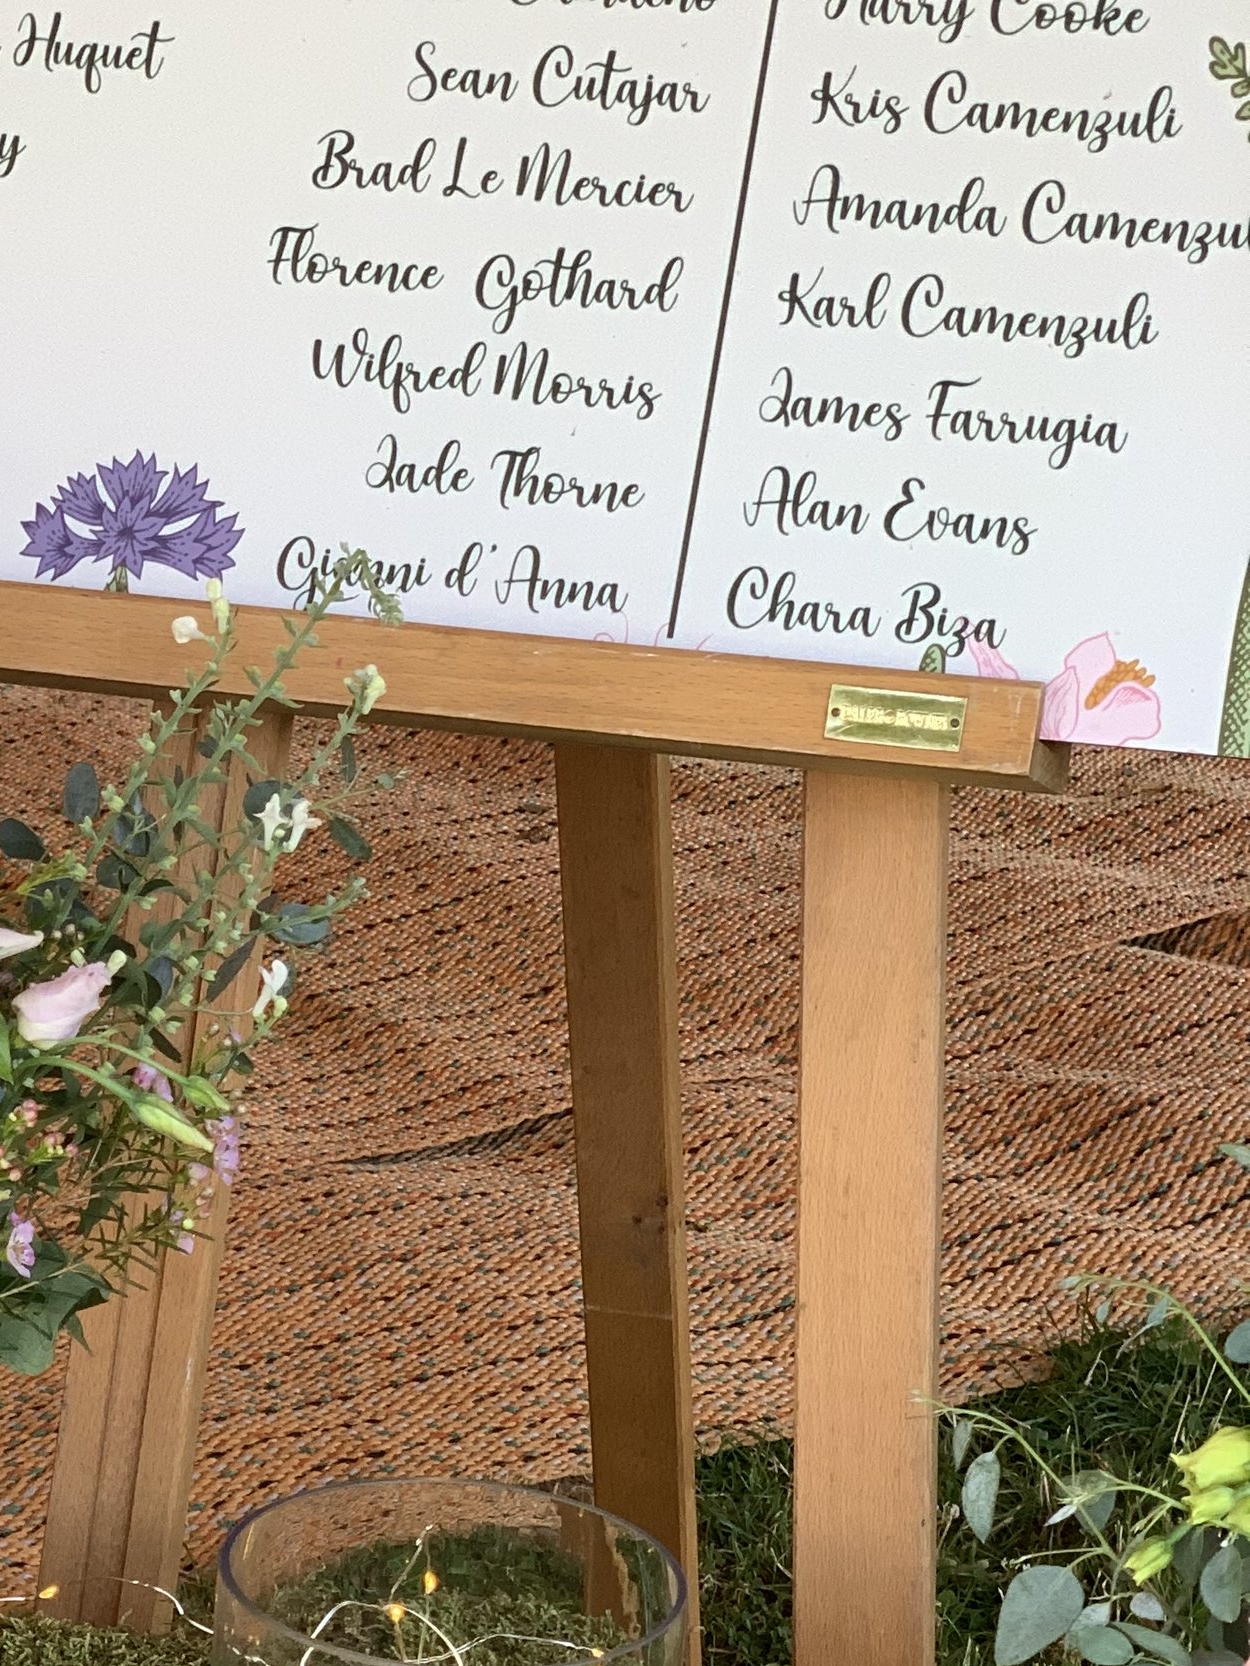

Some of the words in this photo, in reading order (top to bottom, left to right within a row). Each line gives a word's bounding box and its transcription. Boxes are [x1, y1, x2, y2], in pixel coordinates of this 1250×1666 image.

[13, 11, 175, 94] Huquet
[990, 0, 1150, 37] Cooke
[407, 40, 519, 102] Sean
[532, 44, 711, 126] Cutajar
[810, 65, 910, 135] Kris
[924, 69, 1183, 154] Camenzuli
[311, 129, 437, 193] Brad
[442, 136, 504, 199] Le
[515, 142, 695, 213] Mercier
[792, 163, 1007, 237] Amanda
[1021, 179, 1250, 265] Camenzu
[267, 223, 444, 293] Florence
[475, 246, 684, 335] Gothard
[777, 266, 891, 329] Karl
[901, 273, 1159, 359] Camenzuli
[312, 327, 487, 414] Wilfred
[493, 341, 662, 420] Morris
[759, 366, 911, 442] James
[925, 377, 1129, 470] Farrugia
[365, 433, 475, 495] Jade
[490, 446, 645, 513] Thorne
[743, 465, 870, 536] Alan
[883, 477, 1038, 556] Evans
[726, 565, 882, 638] Chara
[894, 582, 1008, 657] Biza
